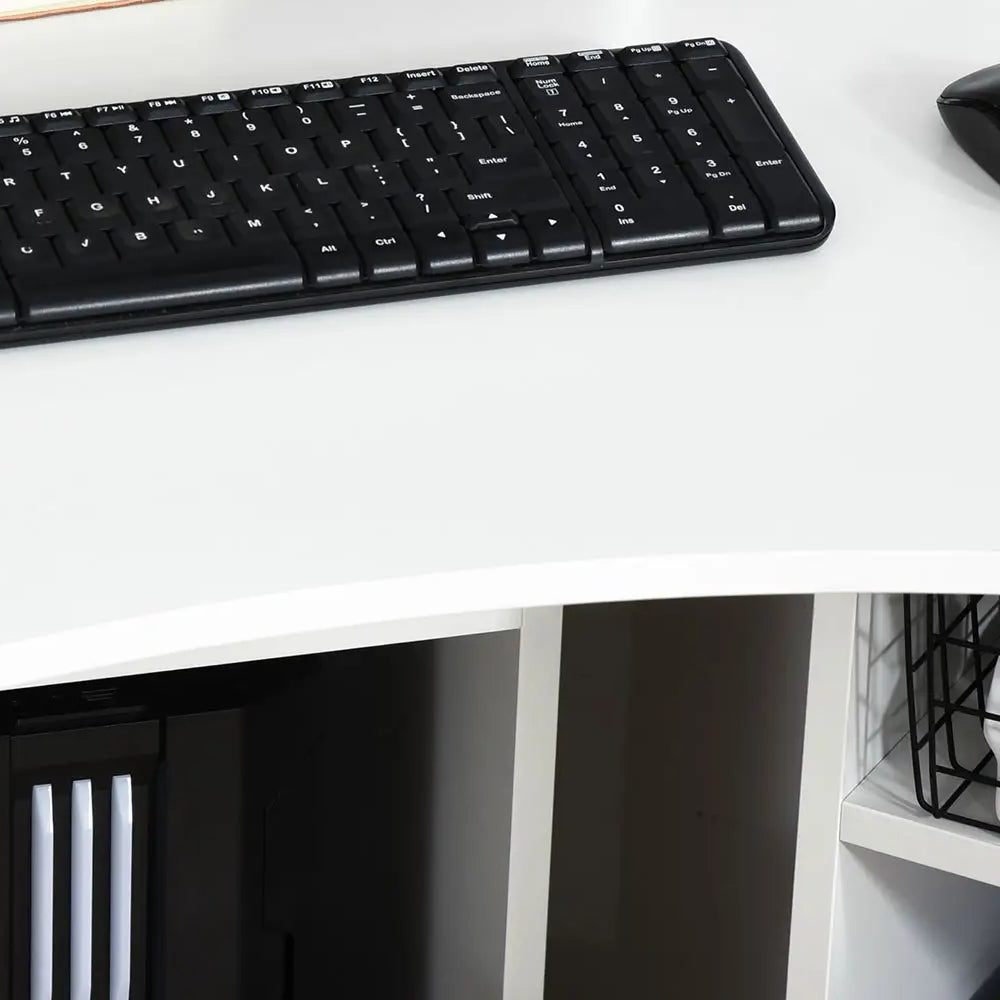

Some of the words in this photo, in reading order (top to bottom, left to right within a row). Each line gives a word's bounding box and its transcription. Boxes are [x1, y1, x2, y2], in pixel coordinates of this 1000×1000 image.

[456, 64, 488, 72] Delete
[406, 70, 435, 78] Insert
[451, 90, 501, 100] Backspace
[651, 166, 661, 174] 2
[4, 178, 15, 186] R
[260, 184, 272, 192] K
[147, 196, 160, 204] H
[615, 204, 624, 212] 0
[248, 219, 261, 227] M
[135, 232, 147, 240] B
